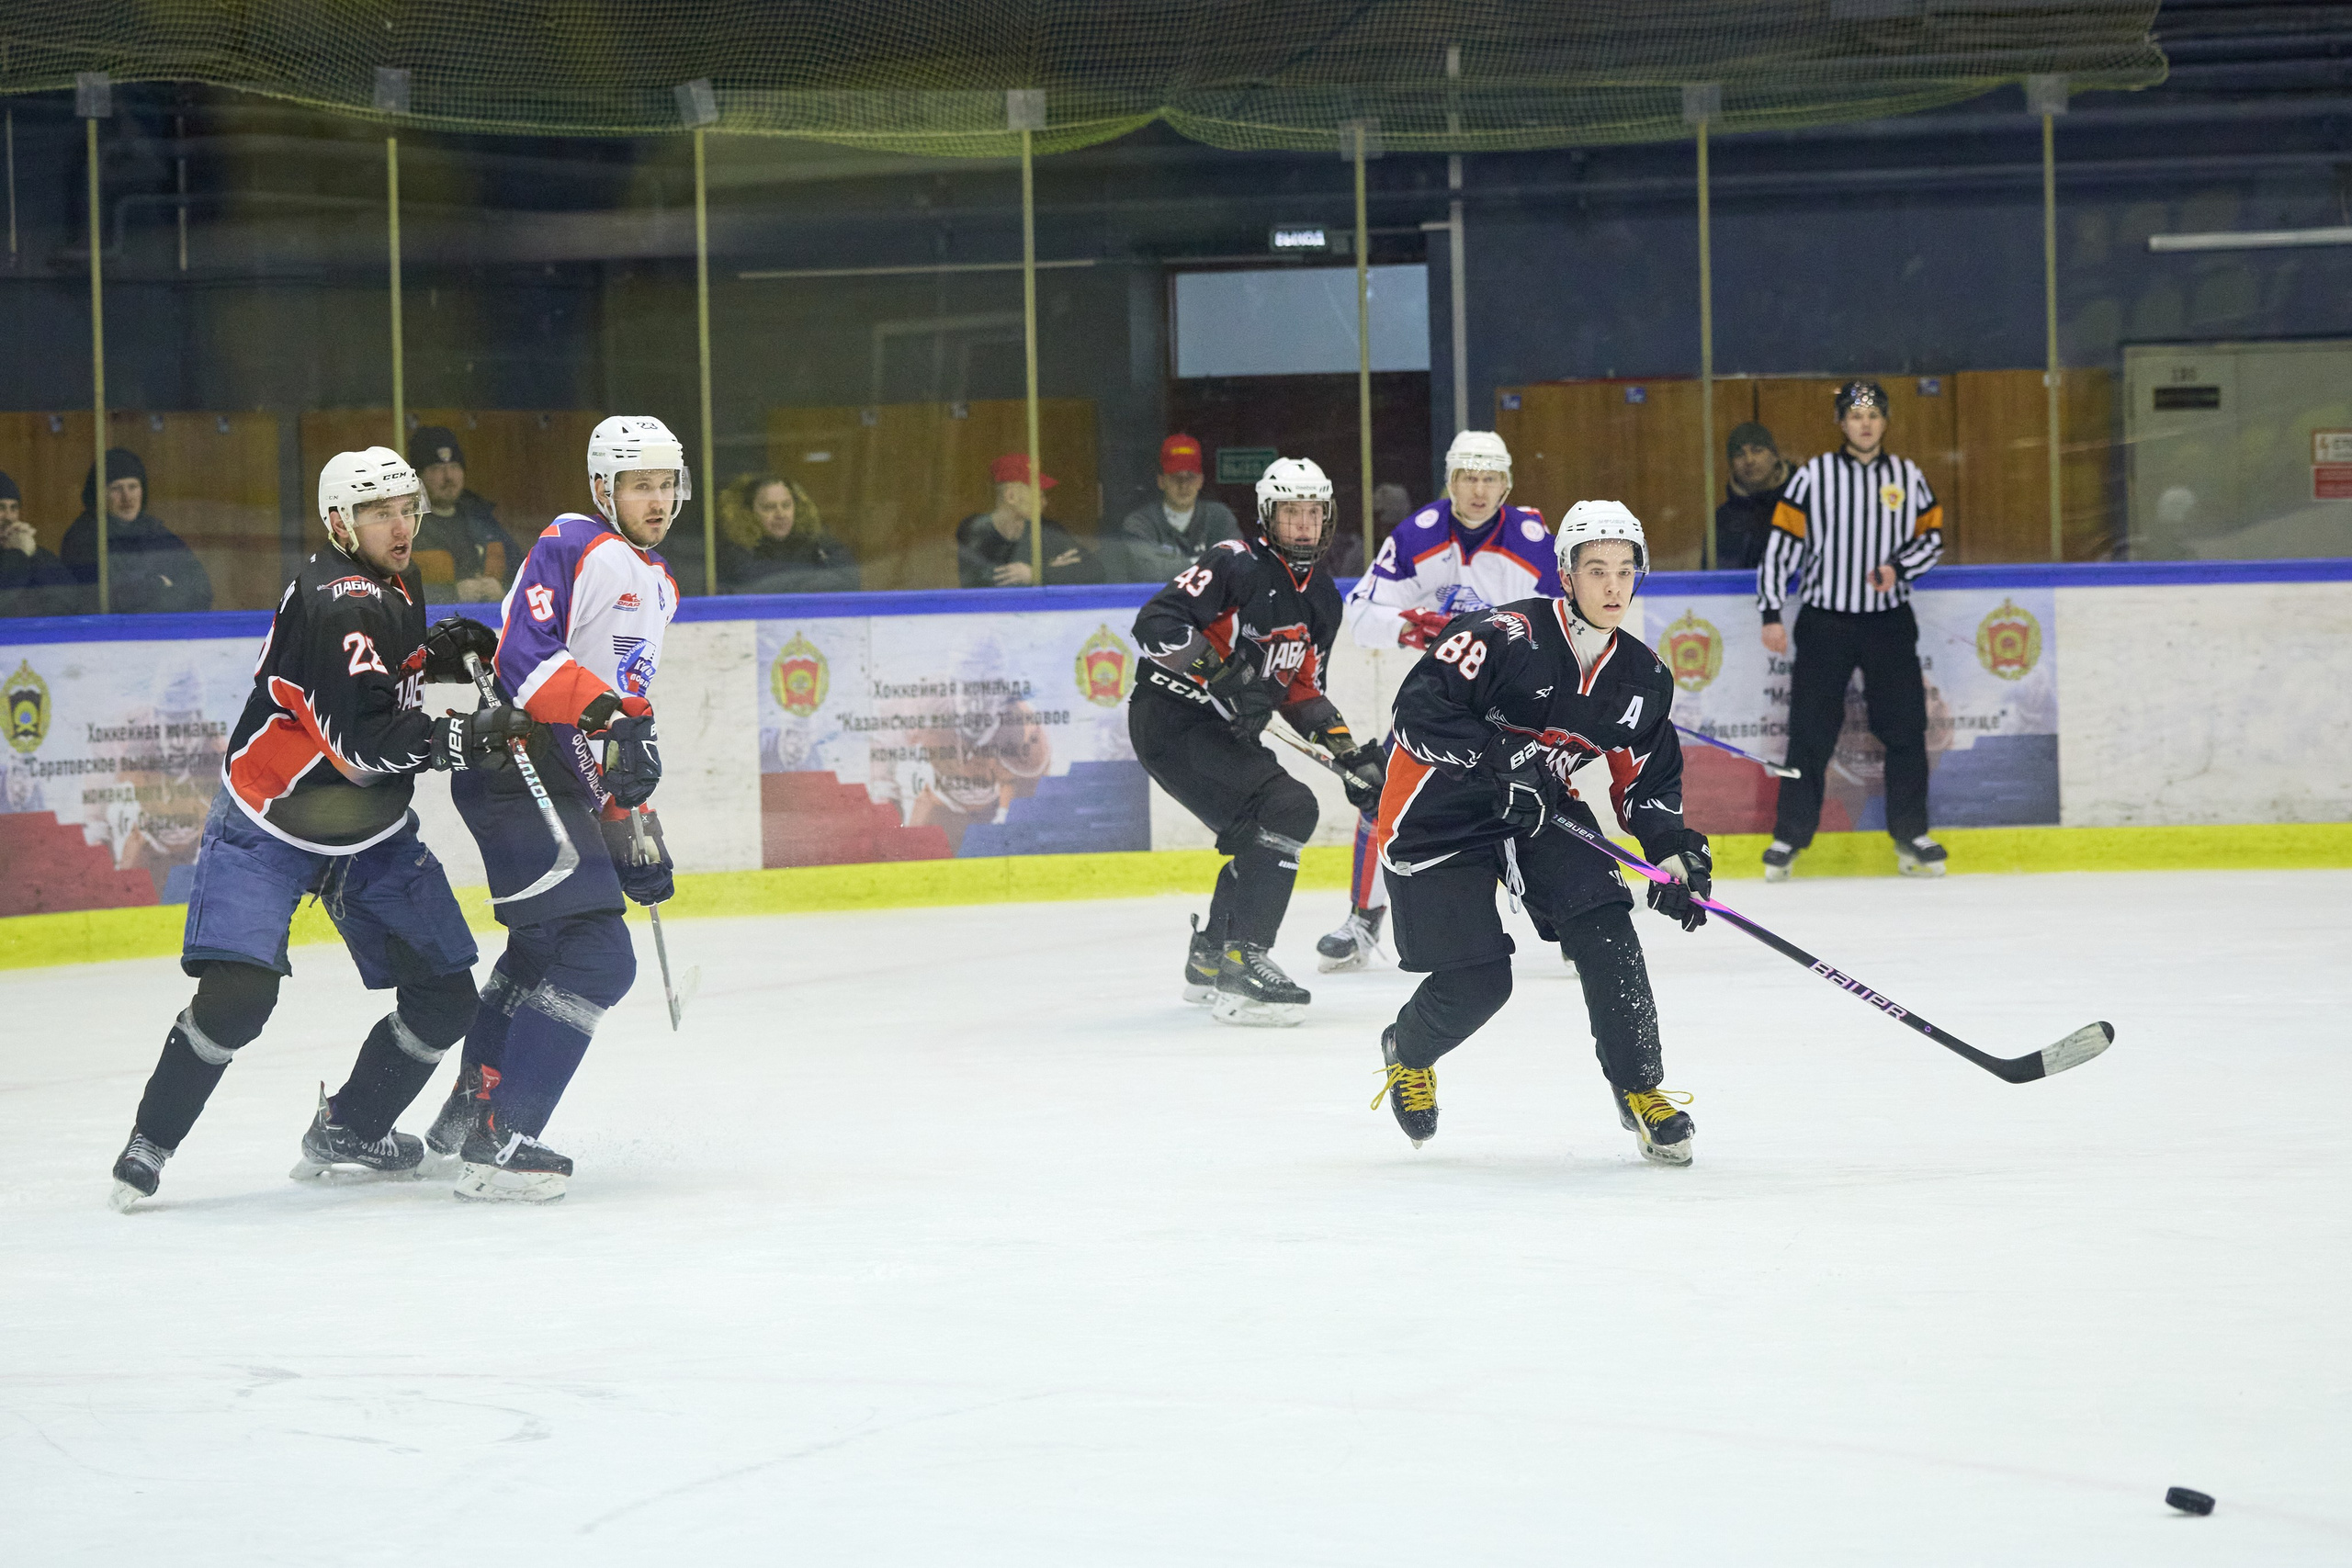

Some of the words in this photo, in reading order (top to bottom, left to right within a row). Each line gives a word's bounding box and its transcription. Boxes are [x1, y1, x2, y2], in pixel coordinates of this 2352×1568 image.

[382, 471, 407, 480] CCM
[1173, 564, 1213, 597] 43
[526, 583, 554, 622] 5
[1435, 631, 1487, 680] 88
[873, 678, 957, 700] Хоккейная
[964, 678, 1033, 698] команда
[1149, 671, 1213, 705] CCM
[1617, 695, 1644, 729] A
[86, 719, 161, 743] Хоккейная
[571, 733, 595, 773] ФОНД
[1556, 816, 1596, 840] BAUER
[1809, 960, 1908, 1020] BAUER
